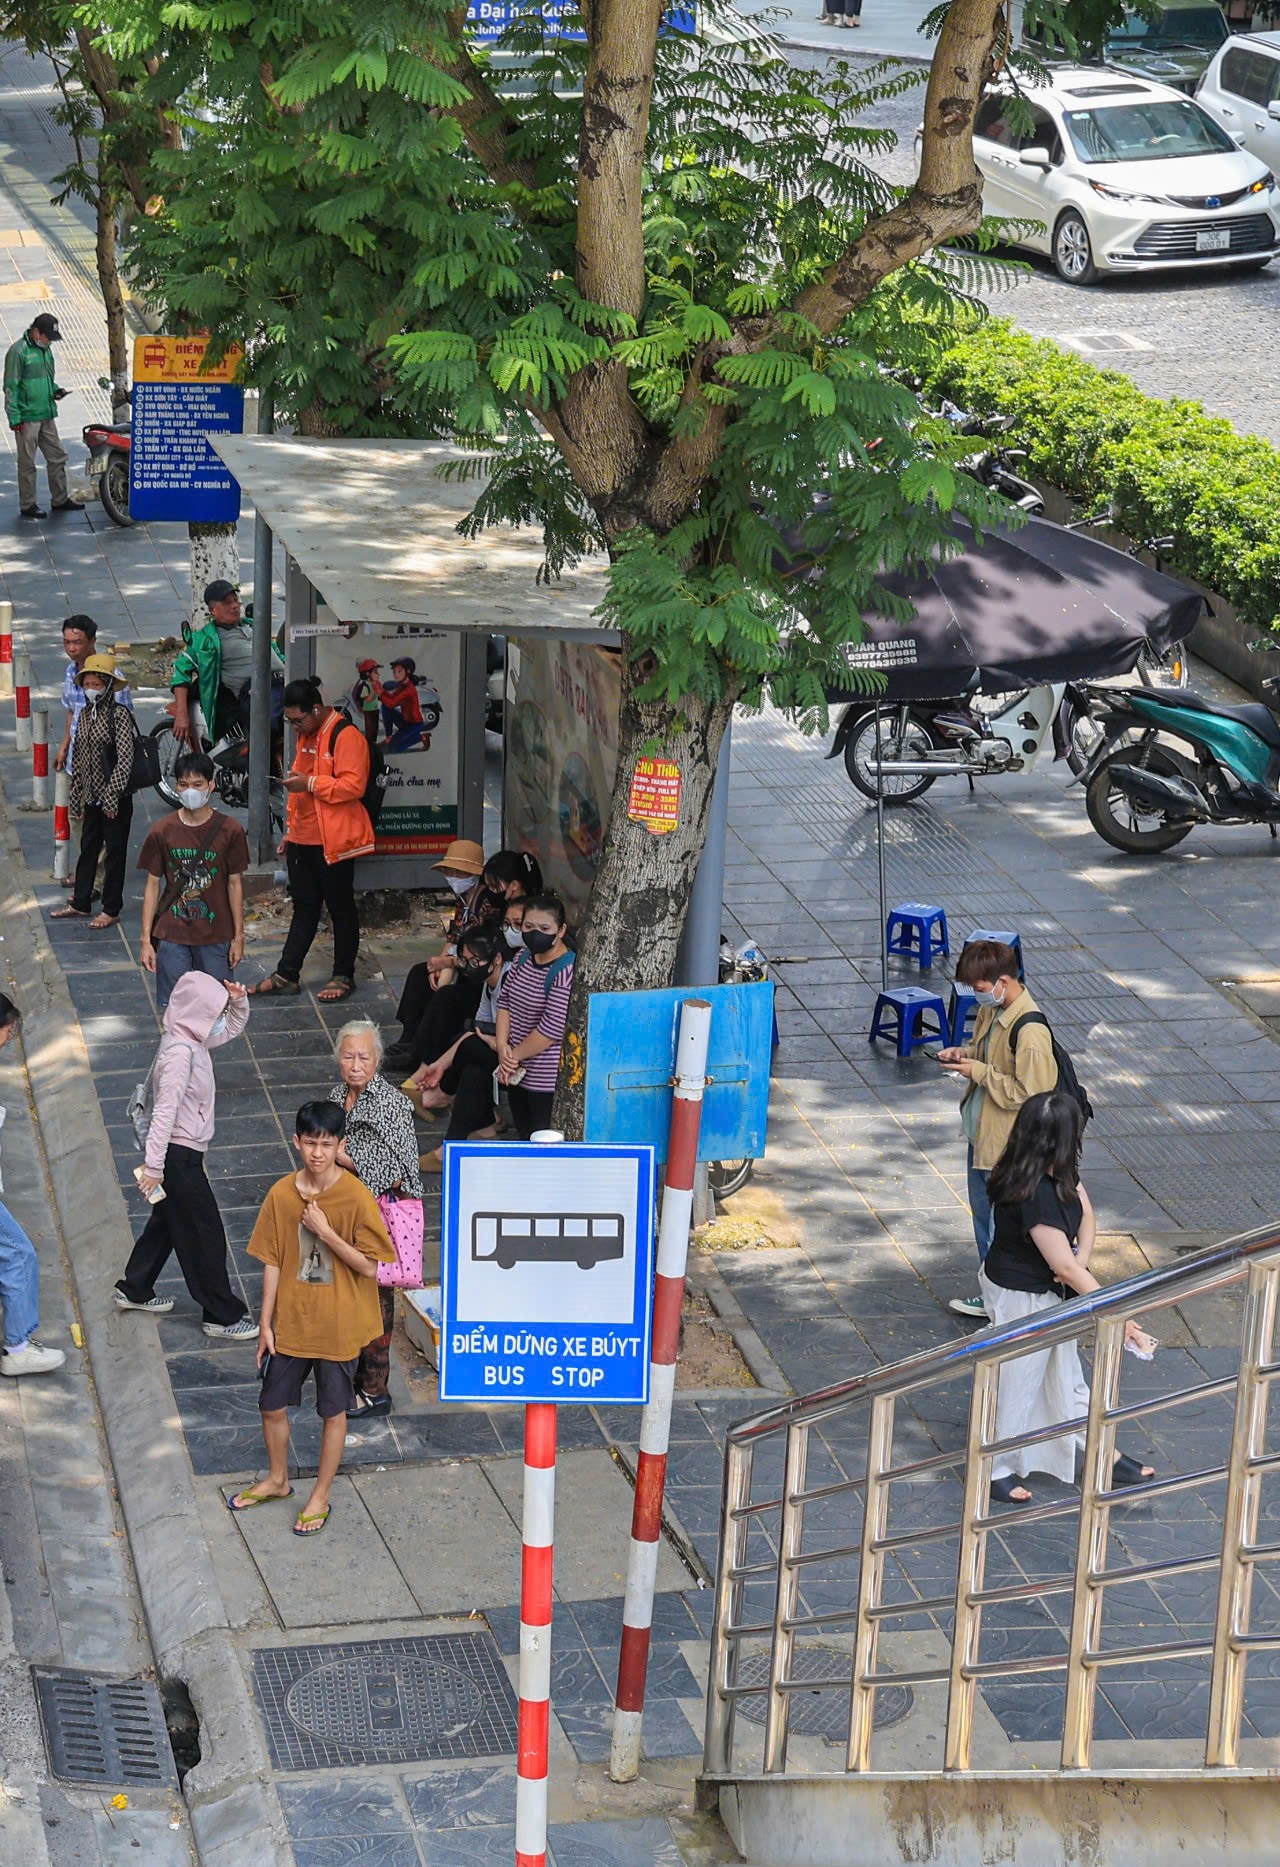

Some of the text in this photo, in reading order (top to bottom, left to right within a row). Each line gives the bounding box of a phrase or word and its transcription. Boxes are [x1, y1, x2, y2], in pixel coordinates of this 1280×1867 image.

[480, 3, 505, 21] Đại
[175, 342, 204, 354] ĐIỂM
[183, 359, 197, 369] XE
[878, 639, 916, 650] QUANG
[635, 760, 654, 775] CHO
[406, 776, 424, 787] cha
[426, 778, 441, 788] mẹ
[631, 800, 653, 809] STUDIO
[452, 1325, 641, 1357] ĐIỂM DỪNG XE BÚYT
[484, 1365, 605, 1388] BUS STOP
